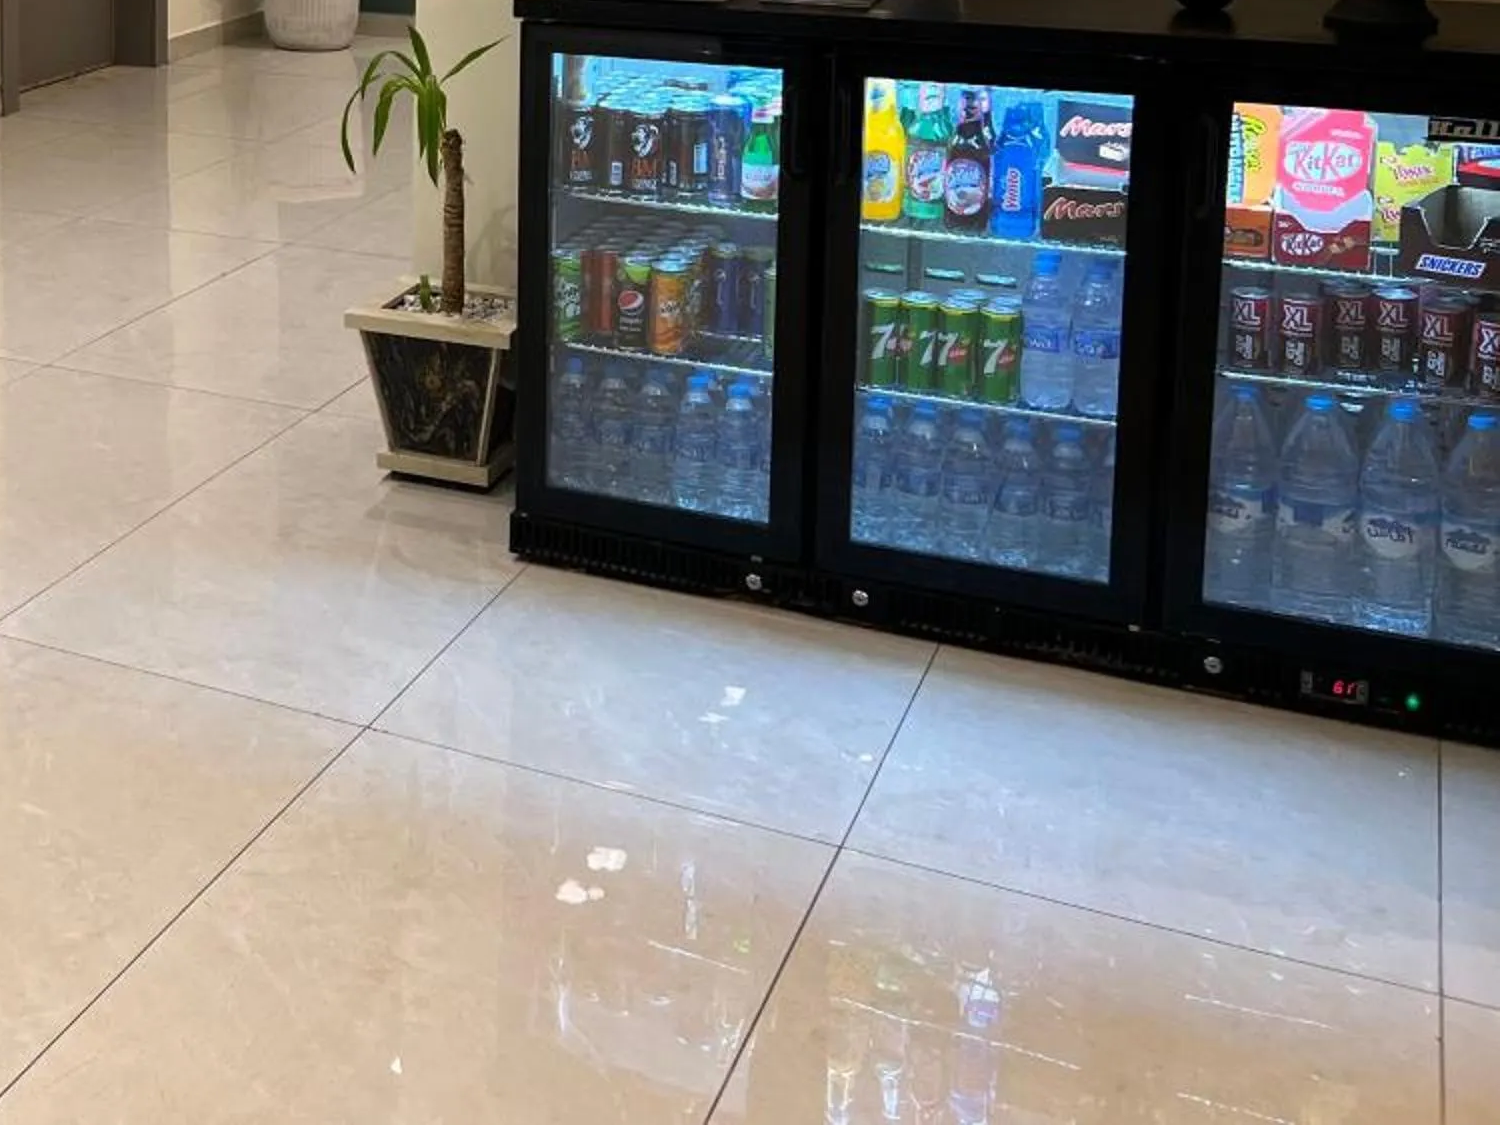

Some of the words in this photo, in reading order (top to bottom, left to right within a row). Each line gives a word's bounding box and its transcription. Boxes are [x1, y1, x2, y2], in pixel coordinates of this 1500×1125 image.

[1420, 256, 1482, 276] SNICKERS
[1234, 300, 1260, 326] XL
[1282, 304, 1313, 332] XL
[1338, 300, 1366, 325] XL
[1378, 300, 1408, 328] XL
[1423, 314, 1453, 342] XL
[1479, 328, 1500, 355] X
